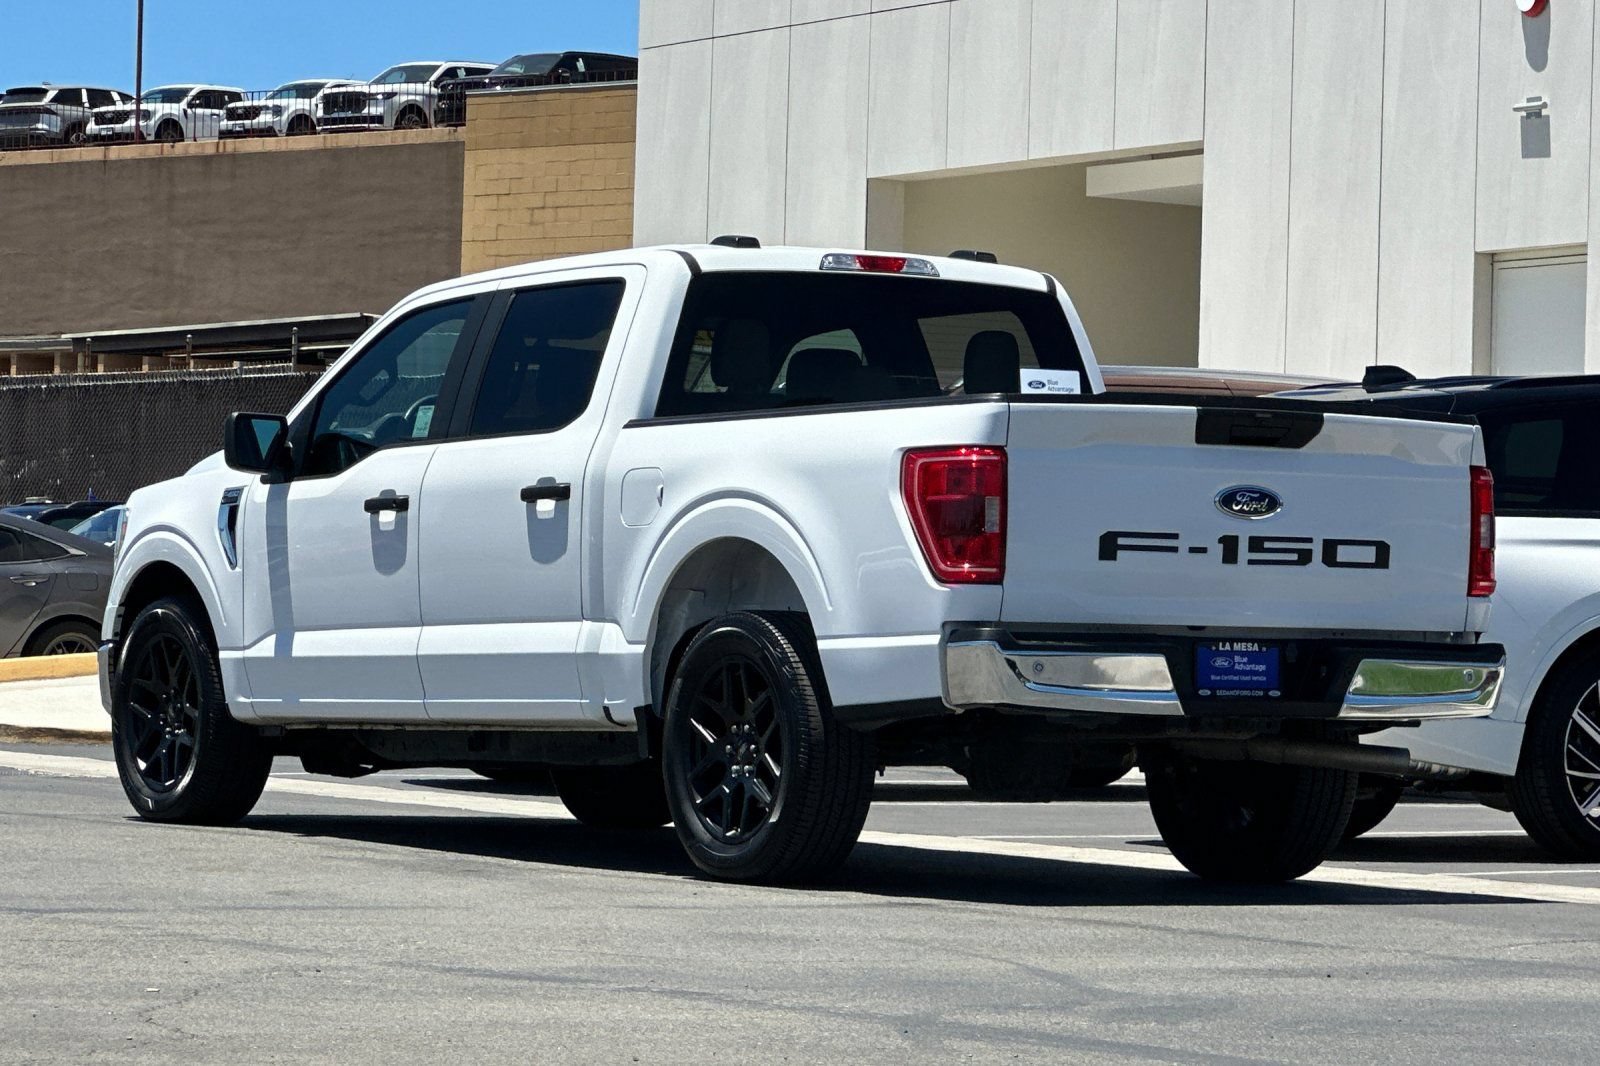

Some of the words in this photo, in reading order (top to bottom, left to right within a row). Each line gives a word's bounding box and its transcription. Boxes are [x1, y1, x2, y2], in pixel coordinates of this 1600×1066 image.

[1098, 530, 1391, 570] F-150
[1219, 642, 1231, 651] LA
[1233, 642, 1259, 652] MESA
[1234, 655, 1248, 663] Blue
[1234, 663, 1266, 671] Advantage
